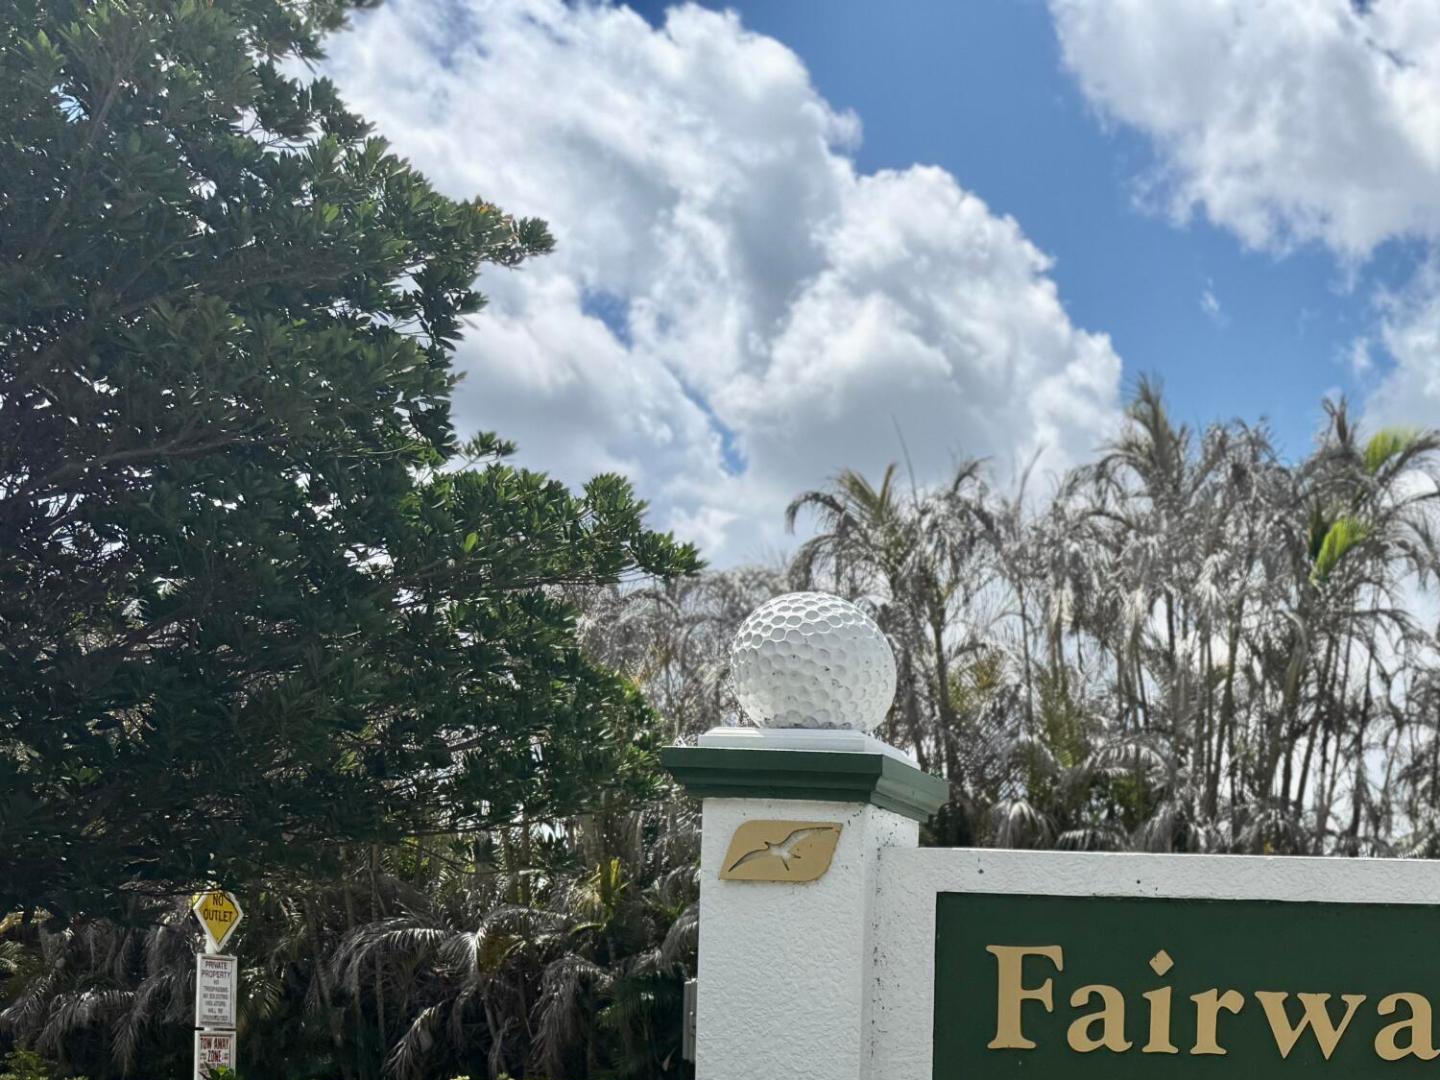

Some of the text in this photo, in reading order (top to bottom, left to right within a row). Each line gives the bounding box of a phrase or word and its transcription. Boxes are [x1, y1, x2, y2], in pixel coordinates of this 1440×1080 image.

[213, 893, 224, 906] NO
[203, 909, 233, 922] OUTLET
[205, 960, 228, 970] PRIVATE
[201, 969, 232, 979] PROPERTY
[200, 1037, 229, 1050] TOW AWAY
[207, 1050, 222, 1063] ZONE
